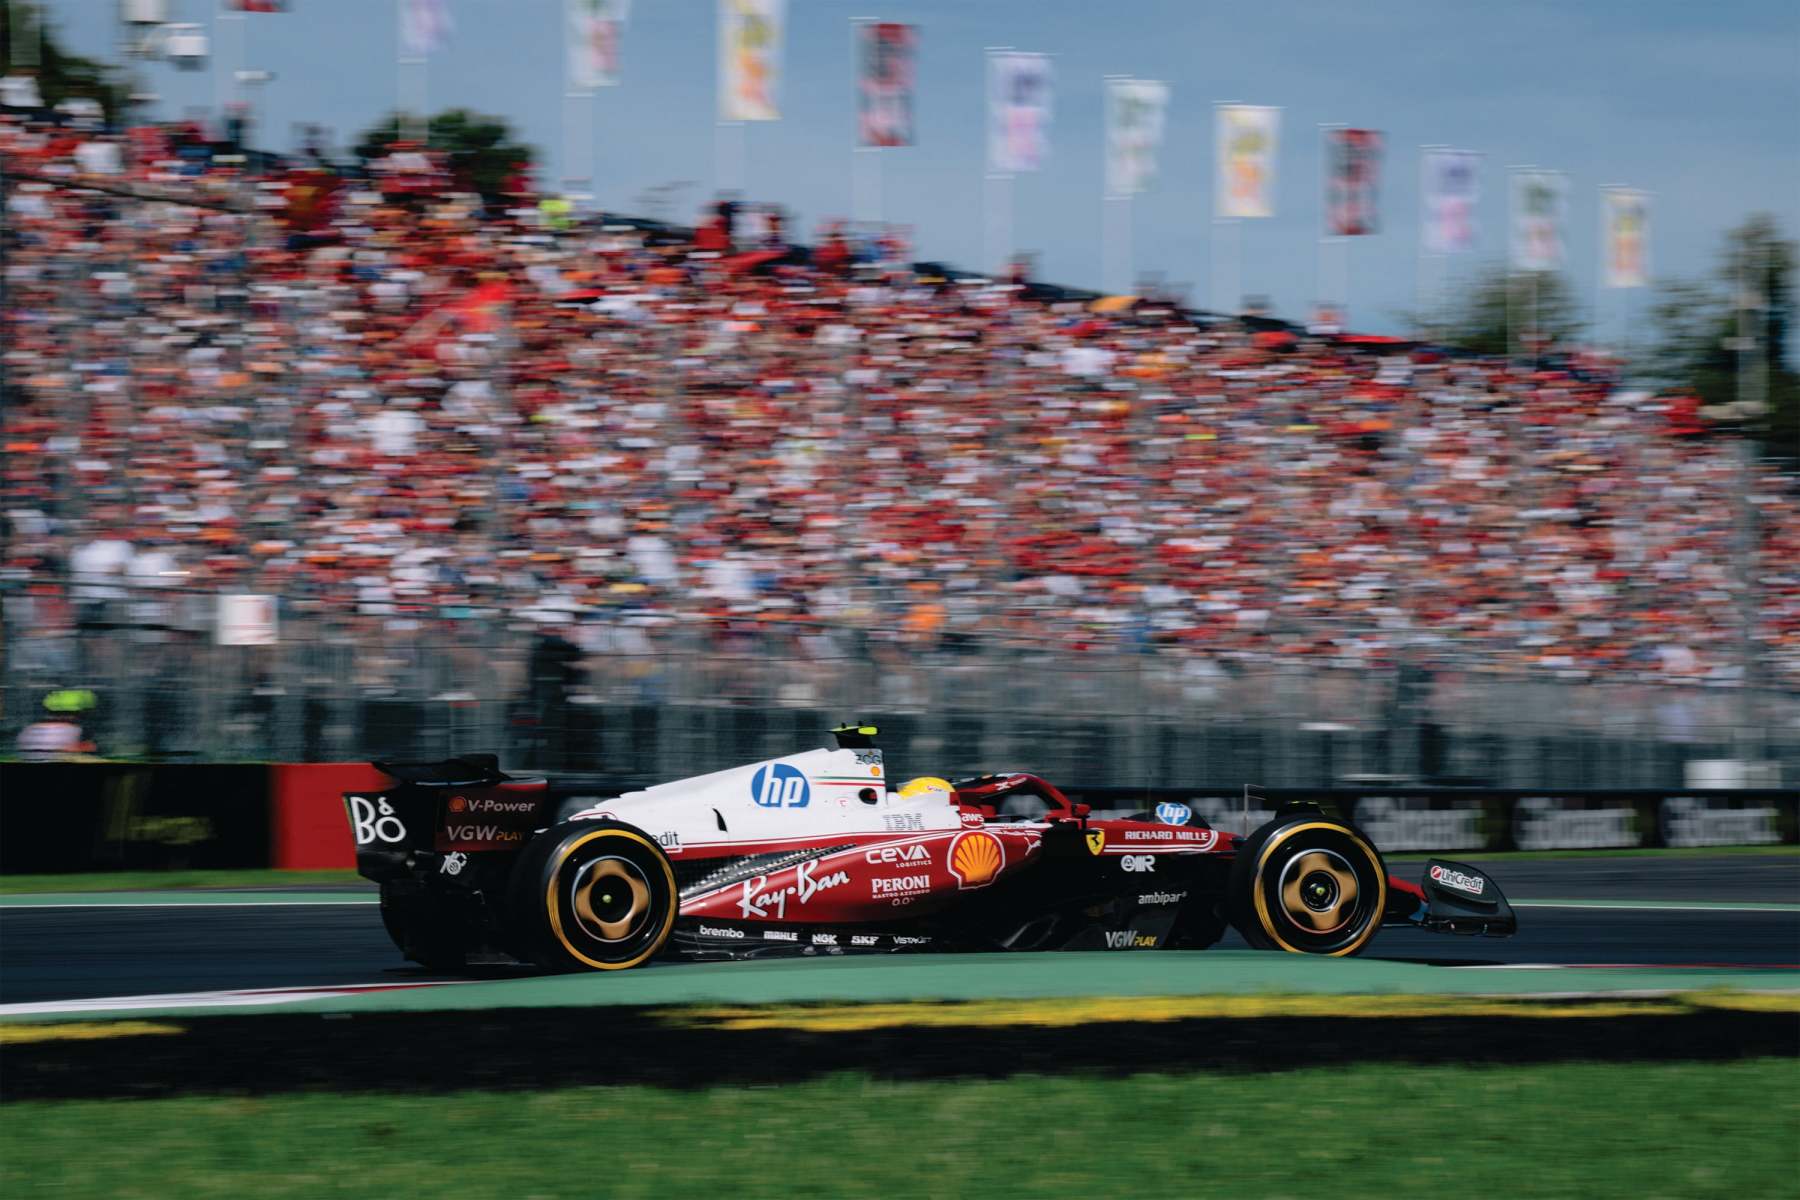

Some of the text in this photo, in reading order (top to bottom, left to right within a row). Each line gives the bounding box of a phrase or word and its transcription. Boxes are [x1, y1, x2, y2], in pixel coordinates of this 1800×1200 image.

[759, 762, 805, 808] hp
[467, 799, 536, 812] V-Power
[961, 813, 985, 823] aws
[1162, 804, 1186, 824] hp
[883, 812, 925, 831] IBM
[447, 825, 498, 841] VGW
[1125, 831, 1209, 841] RICHARD MILLE
[896, 860, 932, 868] LOGISTICS
[871, 875, 930, 893] PERONI
[1441, 868, 1482, 890] UniCredit
[699, 925, 744, 939] brembo
[763, 930, 798, 941] MAHLE
[811, 933, 838, 945] NGK
[1105, 930, 1157, 948] VGW PLAY
[851, 935, 880, 945] SKF
